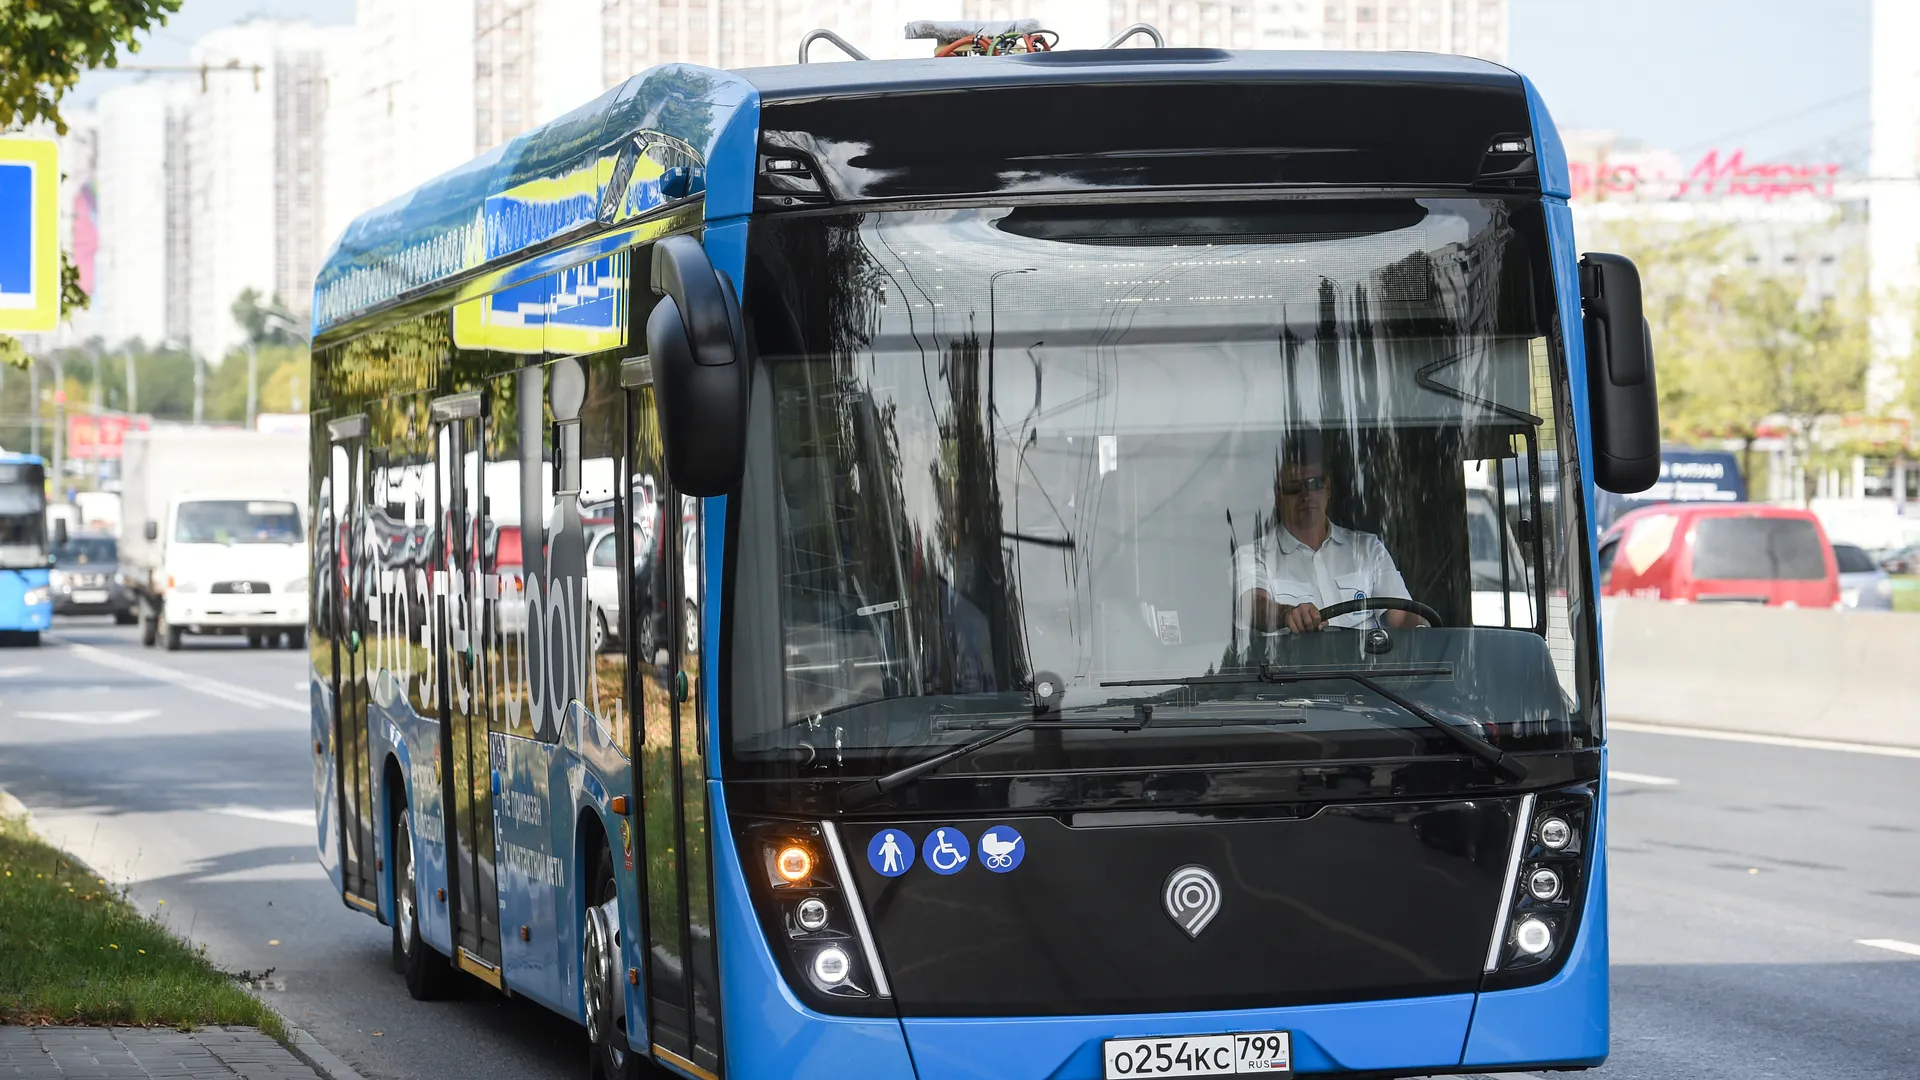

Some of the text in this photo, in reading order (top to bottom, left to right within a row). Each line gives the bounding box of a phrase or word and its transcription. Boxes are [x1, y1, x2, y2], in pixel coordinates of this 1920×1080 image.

[500, 776, 511, 818] Не
[1114, 1036, 1281, 1074] О254КС 799
[1248, 1060, 1270, 1069] RUS
